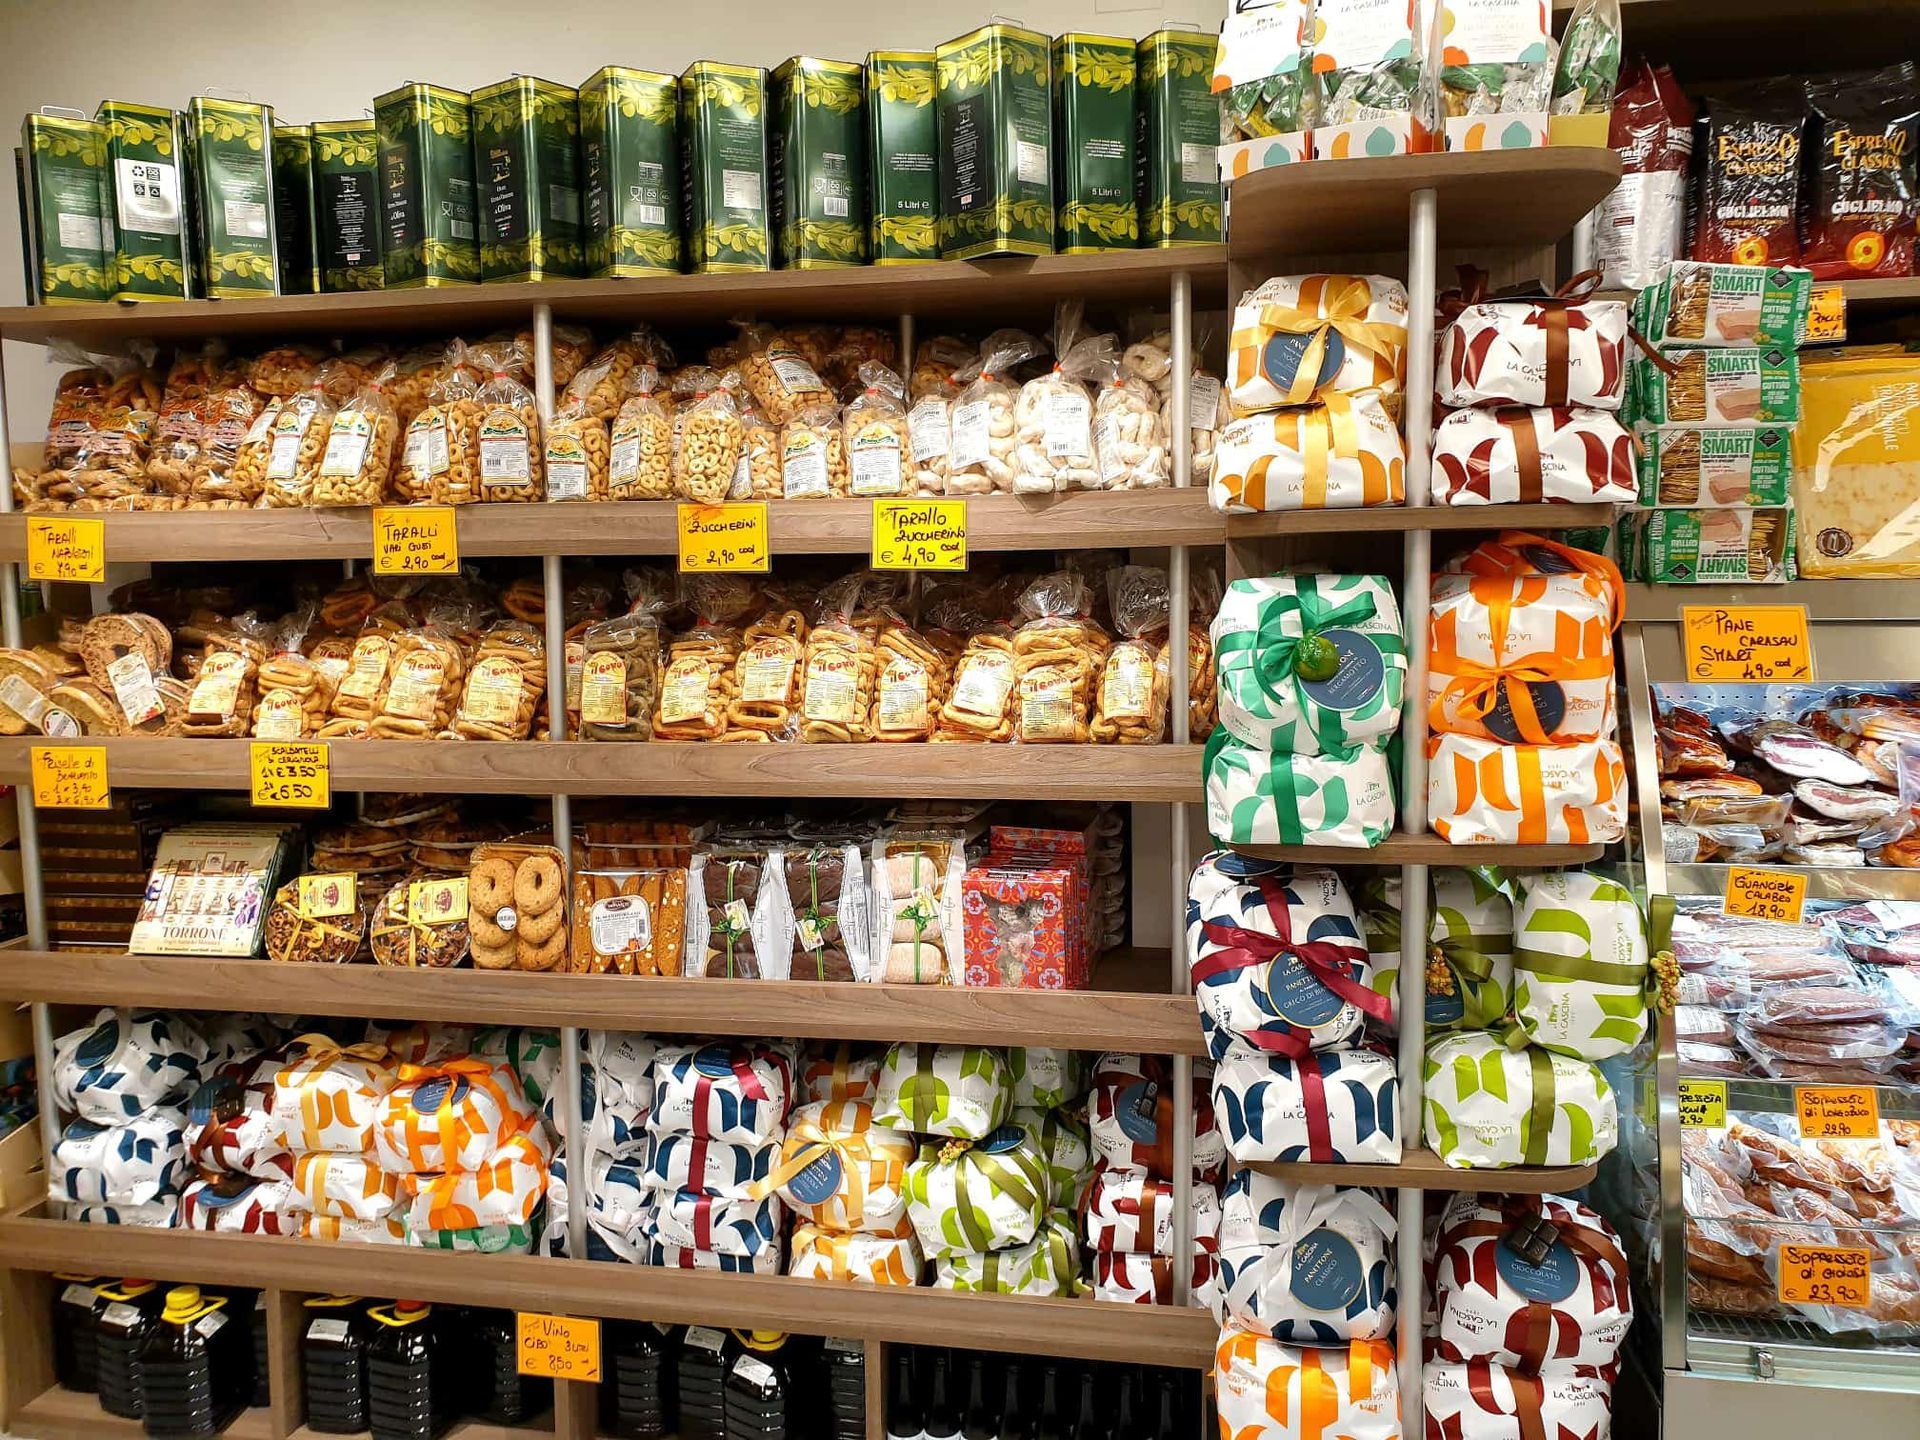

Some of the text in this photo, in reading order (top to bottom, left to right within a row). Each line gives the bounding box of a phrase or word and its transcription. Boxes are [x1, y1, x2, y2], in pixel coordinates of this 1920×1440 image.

[905, 200, 921, 208] Litri
[1712, 275, 1762, 291] SMART
[1708, 357, 1758, 372] SMART
[1703, 438, 1753, 454] SMART
[381, 556, 392, 568] €
[686, 554, 698, 567] €
[882, 551, 894, 563] €
[1698, 559, 1747, 572] SMART
[1715, 610, 1754, 635] PANE
[1739, 635, 1797, 647] CARASAU
[1696, 663, 1713, 677] €
[1730, 904, 1740, 912] €
[1560, 993, 1569, 1029] CASCINA
[1315, 1259, 1337, 1287] CLASSICO
[1511, 1263, 1561, 1281] CIOCCOLATO
[1785, 1288, 1799, 1298] €
[1450, 1305, 1498, 1328] LA CASCINA
[525, 1358, 536, 1369] €
[1553, 1390, 1565, 1400] LA
